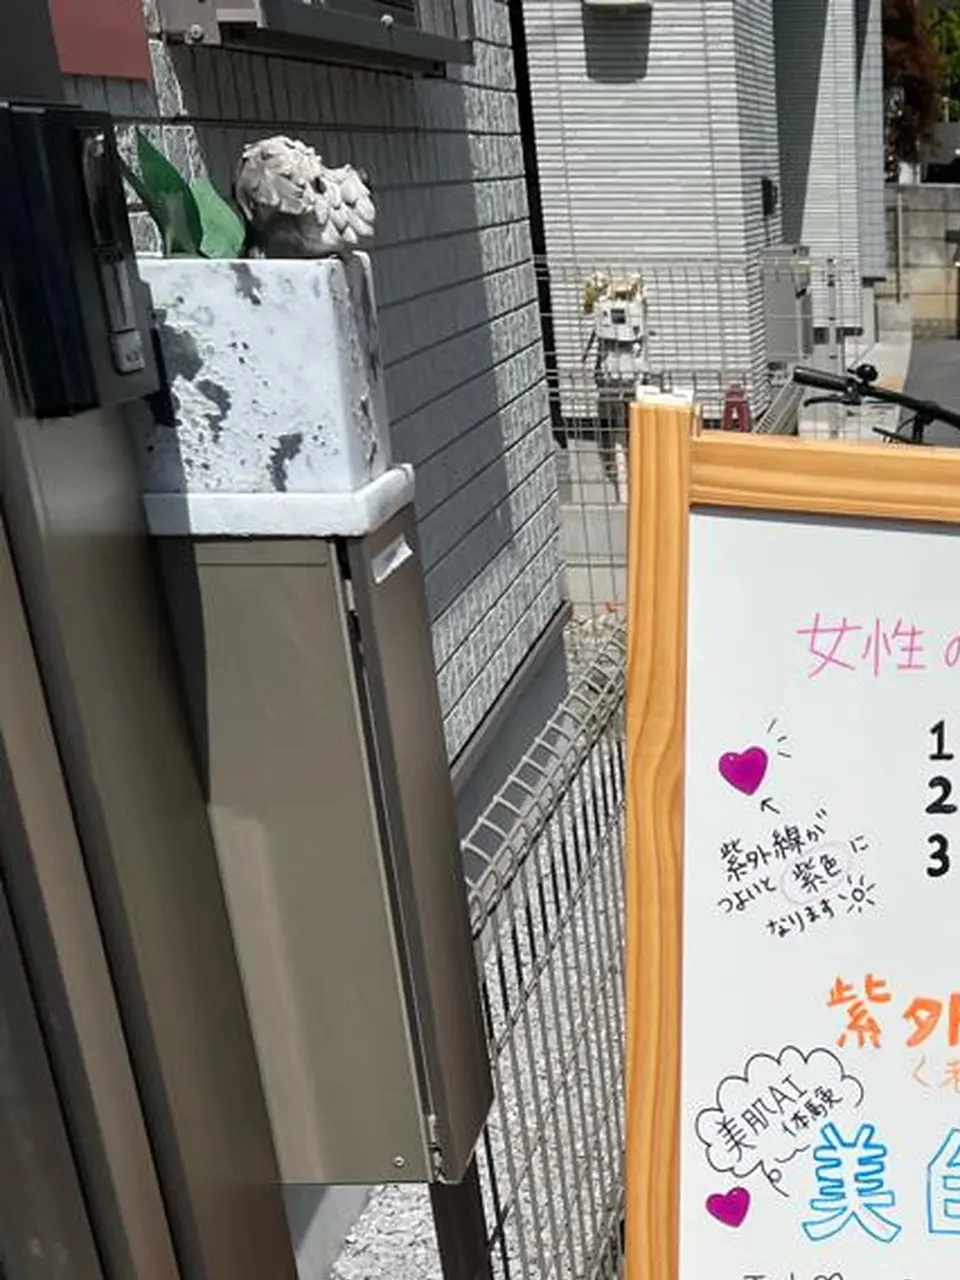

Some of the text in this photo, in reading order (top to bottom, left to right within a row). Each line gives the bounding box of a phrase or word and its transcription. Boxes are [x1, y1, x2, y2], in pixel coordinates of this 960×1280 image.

[927, 718, 956, 762] 1
[924, 775, 959, 816] 2
[720, 808, 828, 882] 紫外線が
[925, 832, 952, 879] 3
